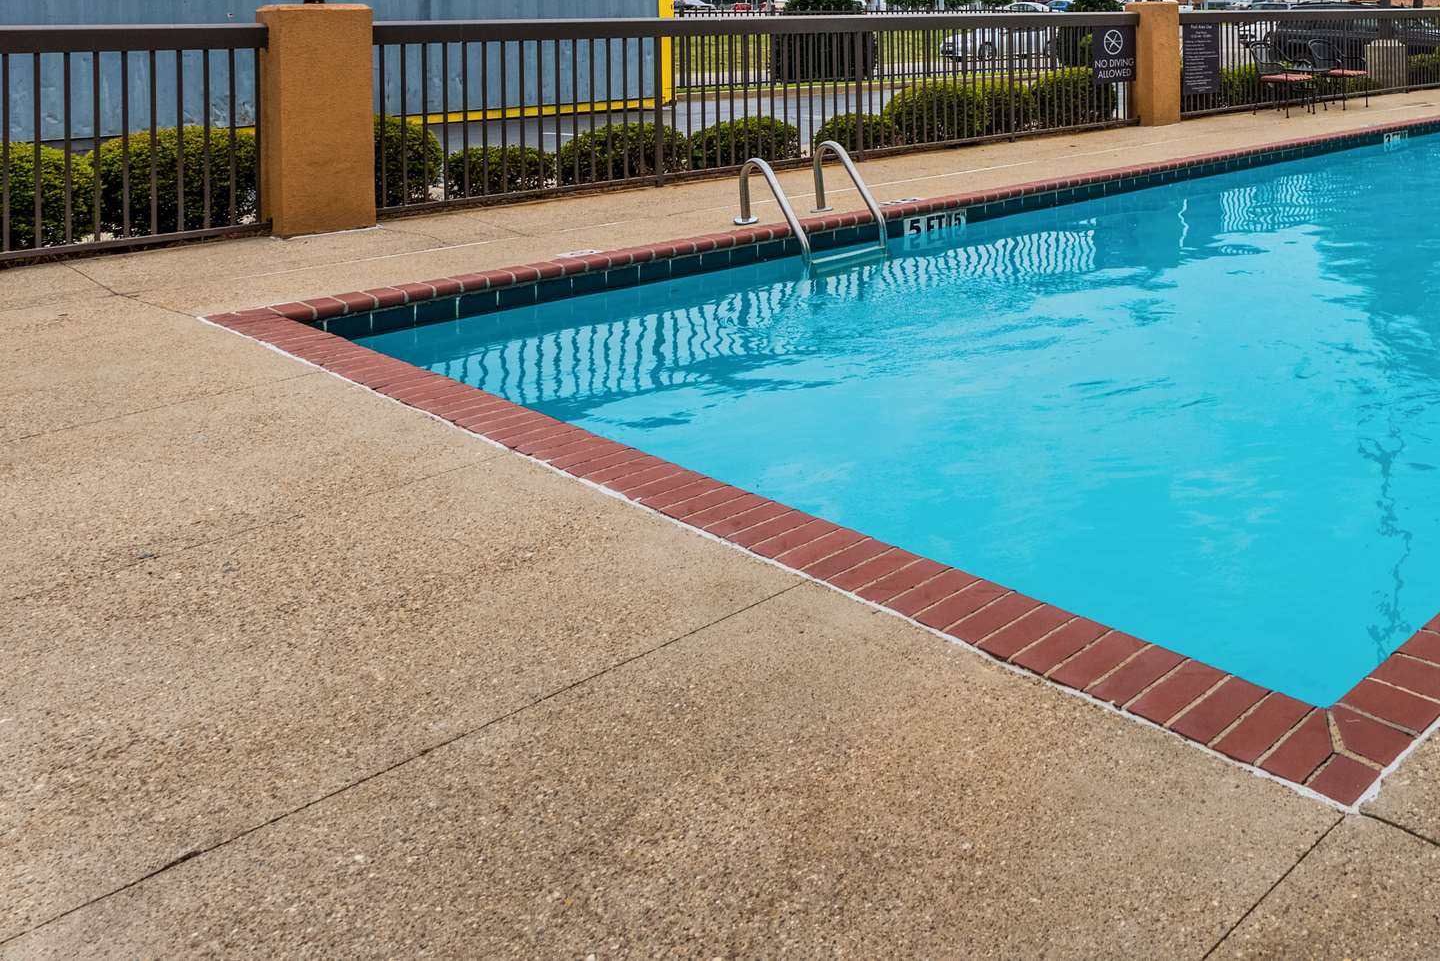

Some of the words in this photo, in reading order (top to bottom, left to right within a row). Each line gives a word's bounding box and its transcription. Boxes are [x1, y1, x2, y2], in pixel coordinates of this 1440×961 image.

[1094, 59, 1108, 69] NO
[1109, 58, 1135, 68] DIVING
[1097, 68, 1132, 79] ALLOWED
[908, 218, 922, 236] 5
[926, 214, 945, 232] FT
